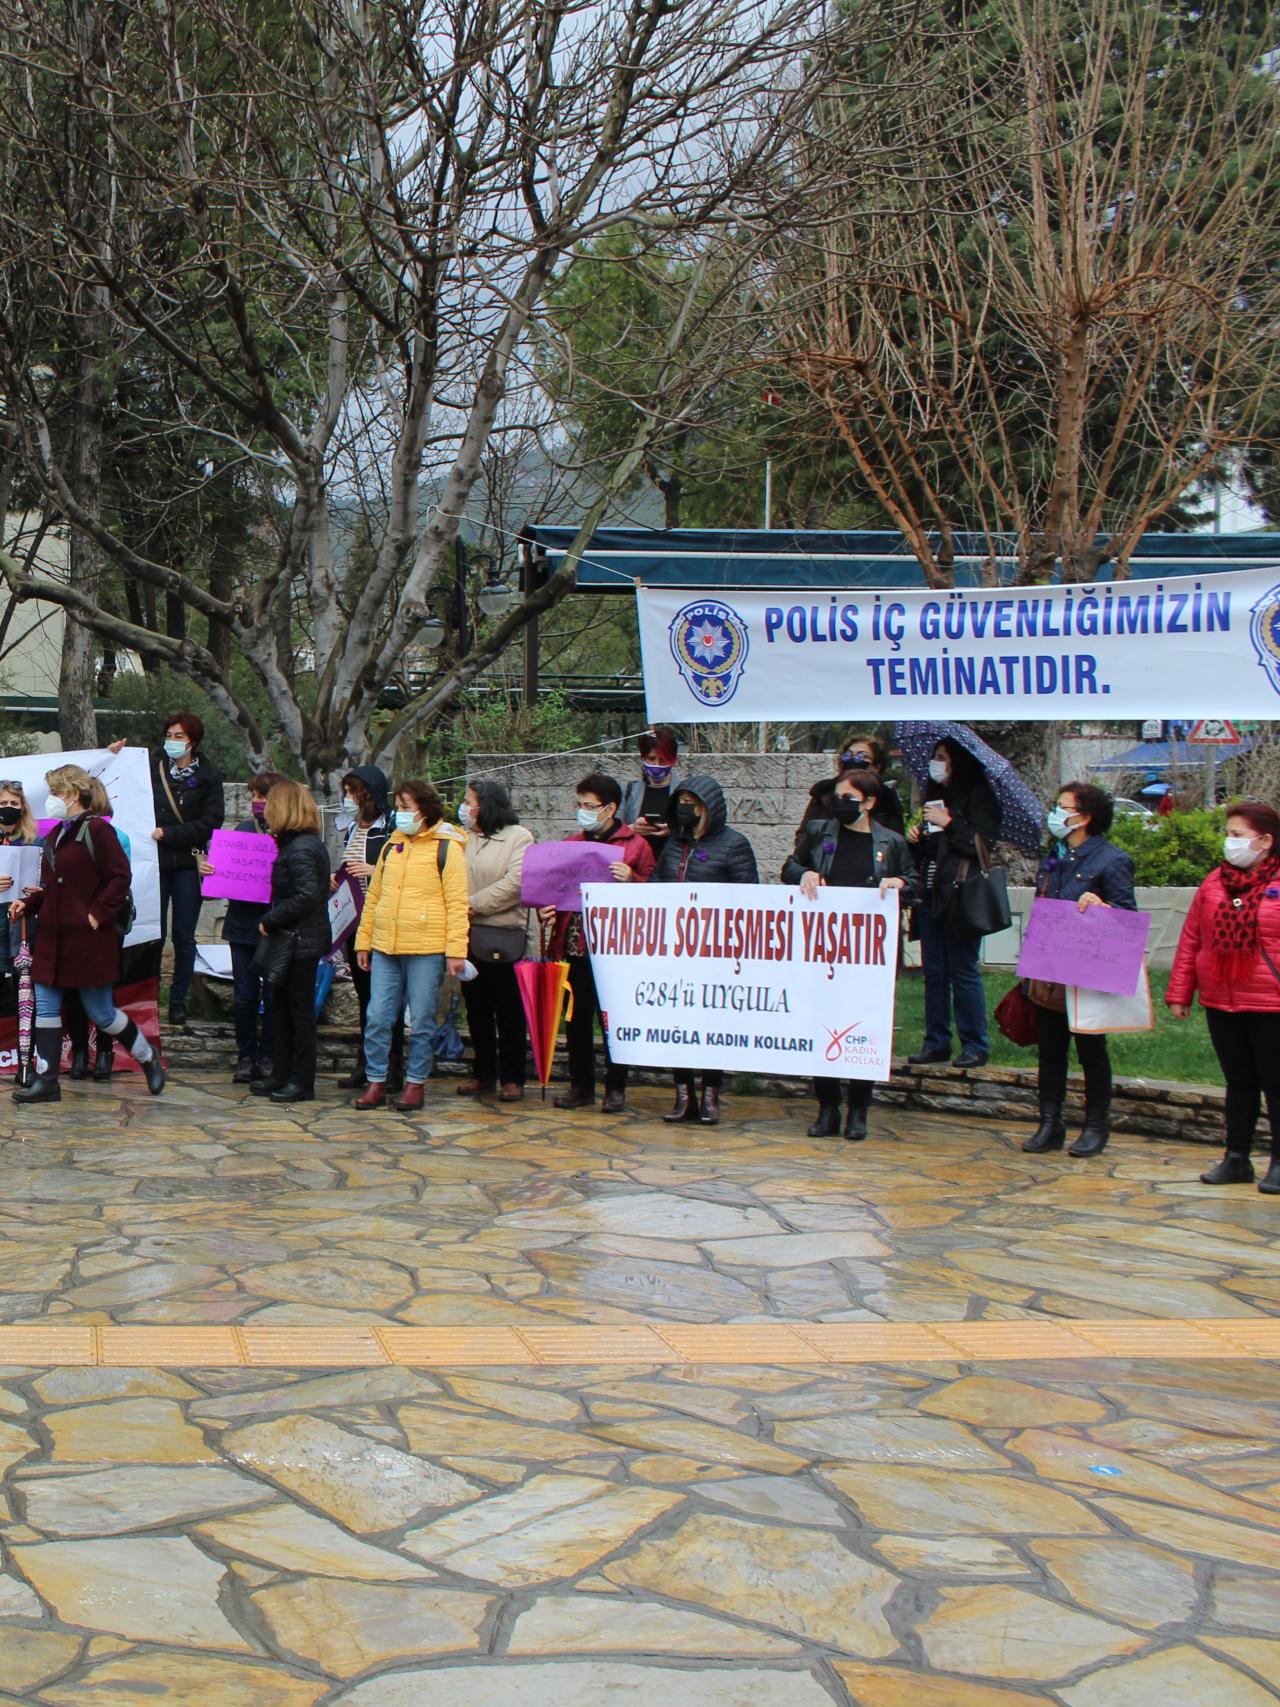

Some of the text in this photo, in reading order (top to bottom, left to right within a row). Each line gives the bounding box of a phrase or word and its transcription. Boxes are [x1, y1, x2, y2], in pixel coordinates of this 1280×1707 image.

[685, 607, 728, 620] POLİS
[764, 583, 1232, 651] POLİS İÇ GÜVENLİĞİMİZİN
[867, 647, 1111, 696] TEMİNATIDIR.
[674, 892, 794, 975] SÖZLEŞMESİ
[801, 911, 887, 980] YAŞATIR
[634, 979, 791, 1013] 6284'ü UYGULA
[616, 1026, 814, 1052] CHP MUĞLA KADIN KOLLARI
[844, 1046, 878, 1056] KADIN
[845, 1035, 868, 1045] CHP
[843, 1055, 885, 1067] KOLLARI
